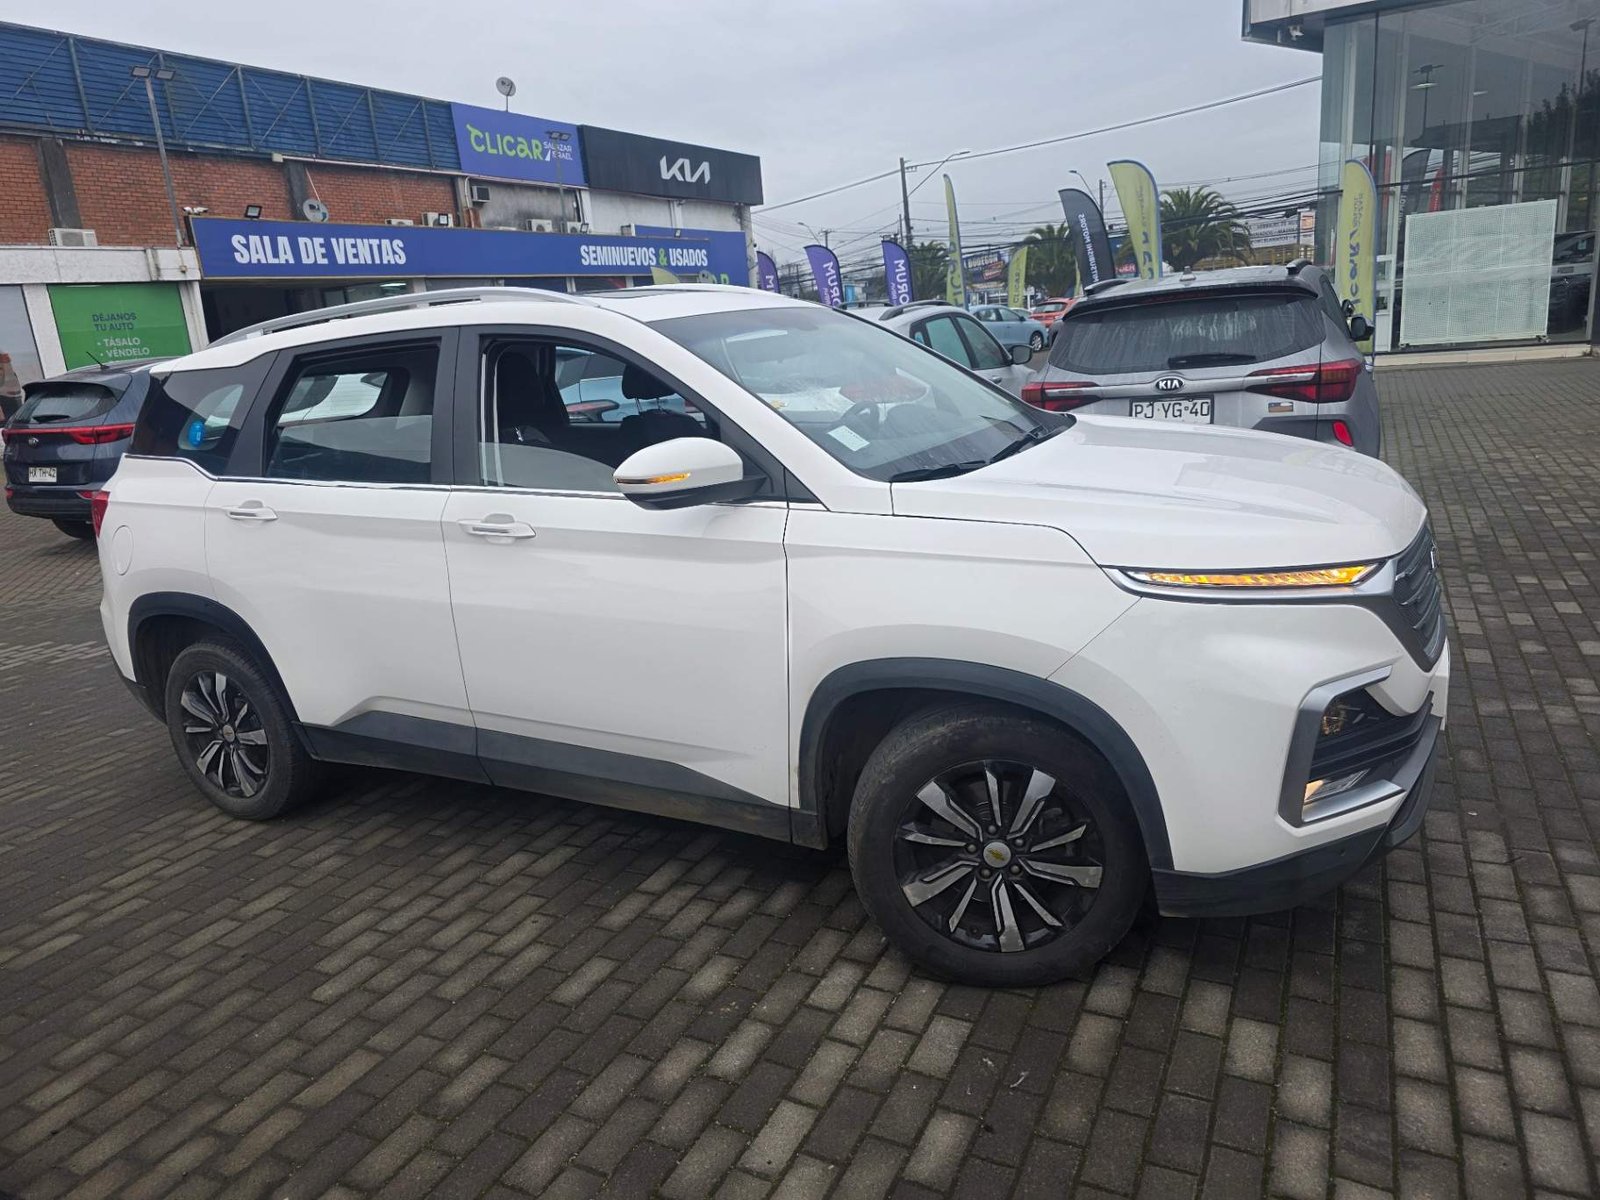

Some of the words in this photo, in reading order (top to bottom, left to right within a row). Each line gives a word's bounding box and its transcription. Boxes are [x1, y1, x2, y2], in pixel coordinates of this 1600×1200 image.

[542, 141, 572, 152] SALZAR
[231, 234, 295, 264] SALA
[298, 237, 329, 265] DE
[331, 237, 407, 265] VENTAS
[580, 244, 657, 266] SEMINUEVOS
[658, 248, 668, 267] &
[669, 248, 709, 267] USADOS
[94, 323, 106, 332] TU
[109, 321, 134, 331] AUTO
[1158, 380, 1180, 390] KIA
